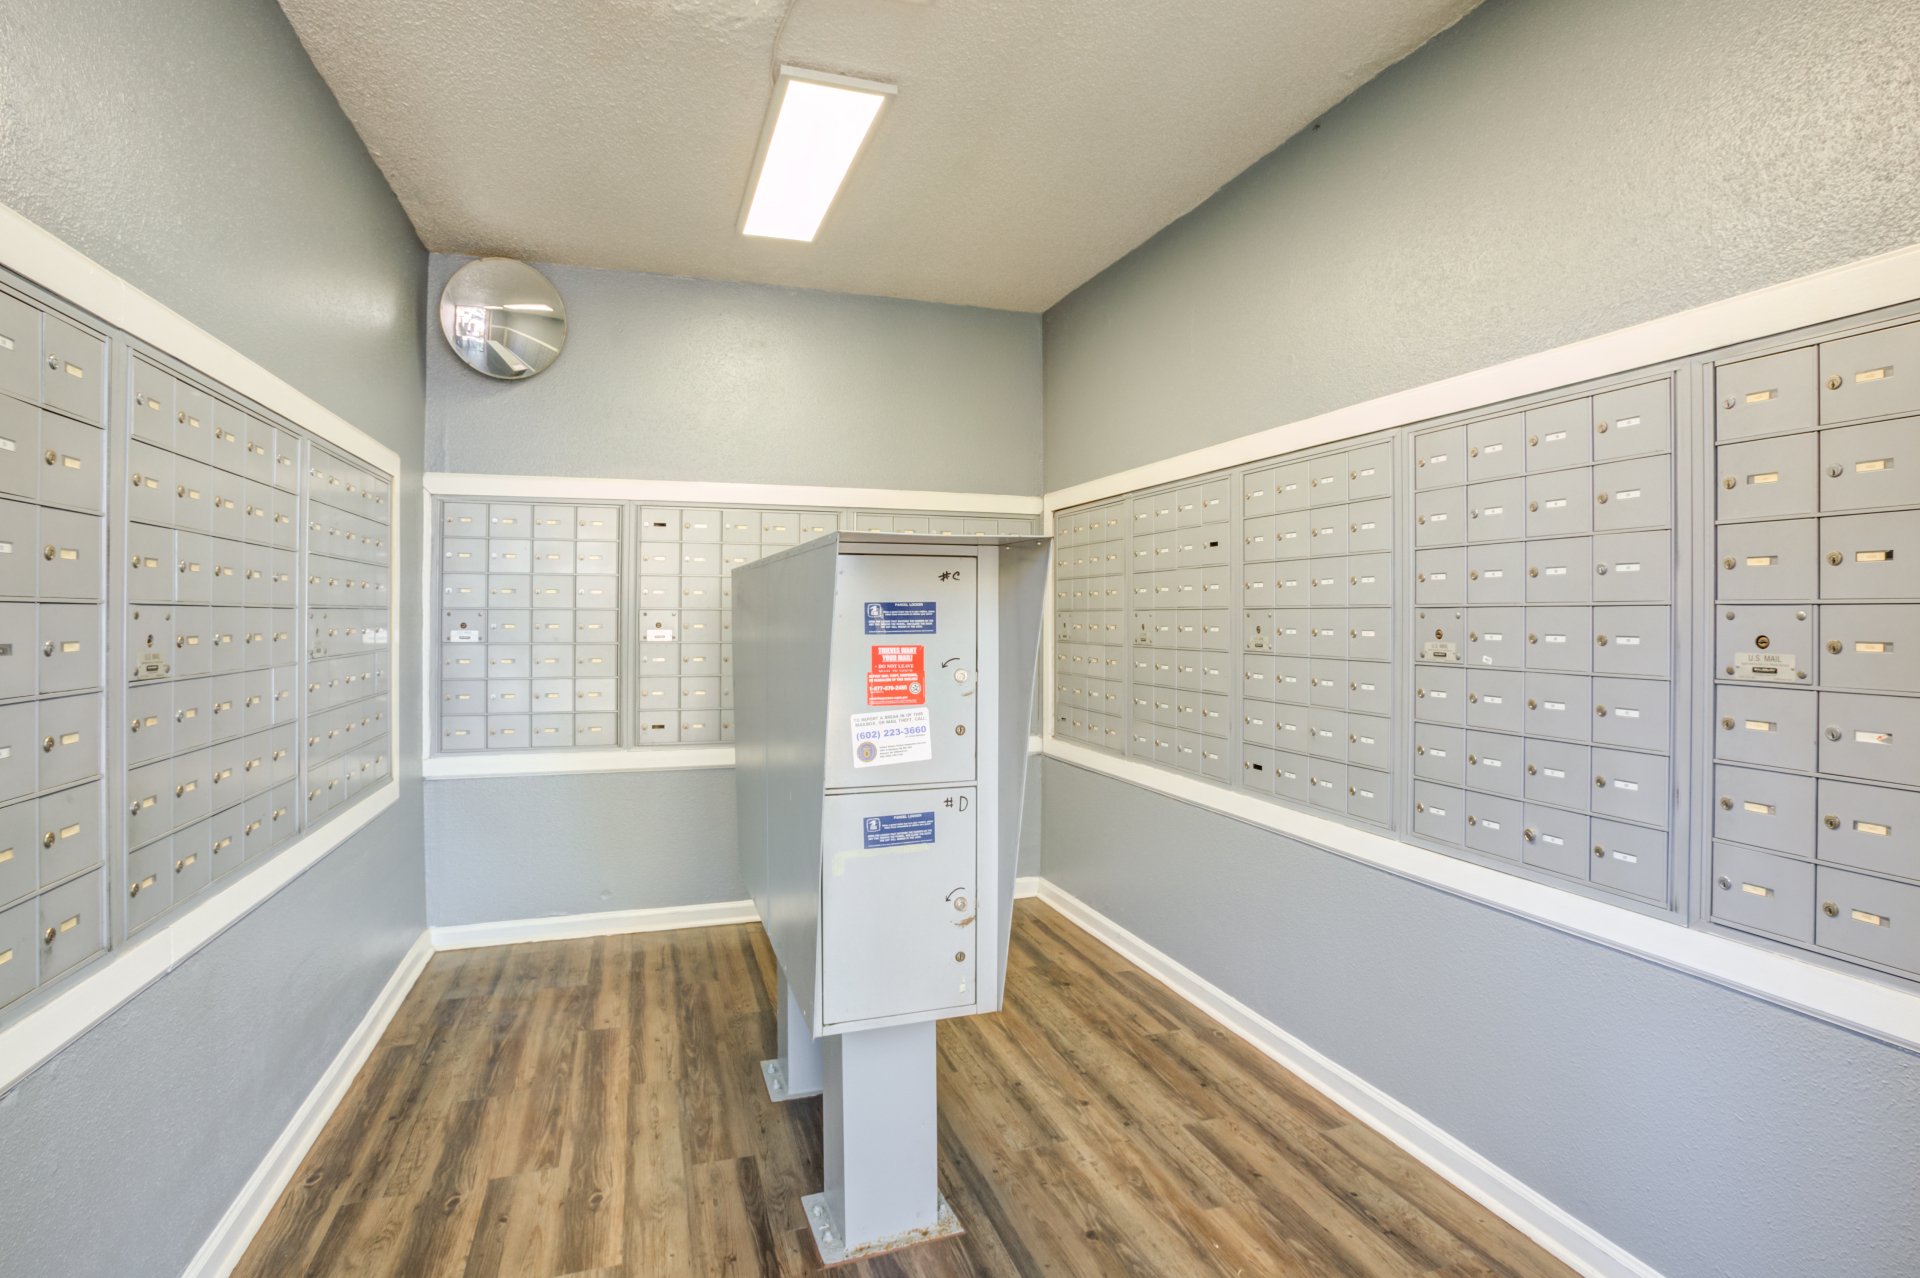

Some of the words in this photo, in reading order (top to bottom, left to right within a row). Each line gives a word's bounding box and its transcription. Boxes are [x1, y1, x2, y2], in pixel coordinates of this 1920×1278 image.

[901, 647, 917, 655] WANT
[882, 655, 897, 663] YOUR
[1764, 655, 1783, 663] MAIL
[856, 730, 881, 741] (602)
[883, 725, 927, 737] 223-3660
